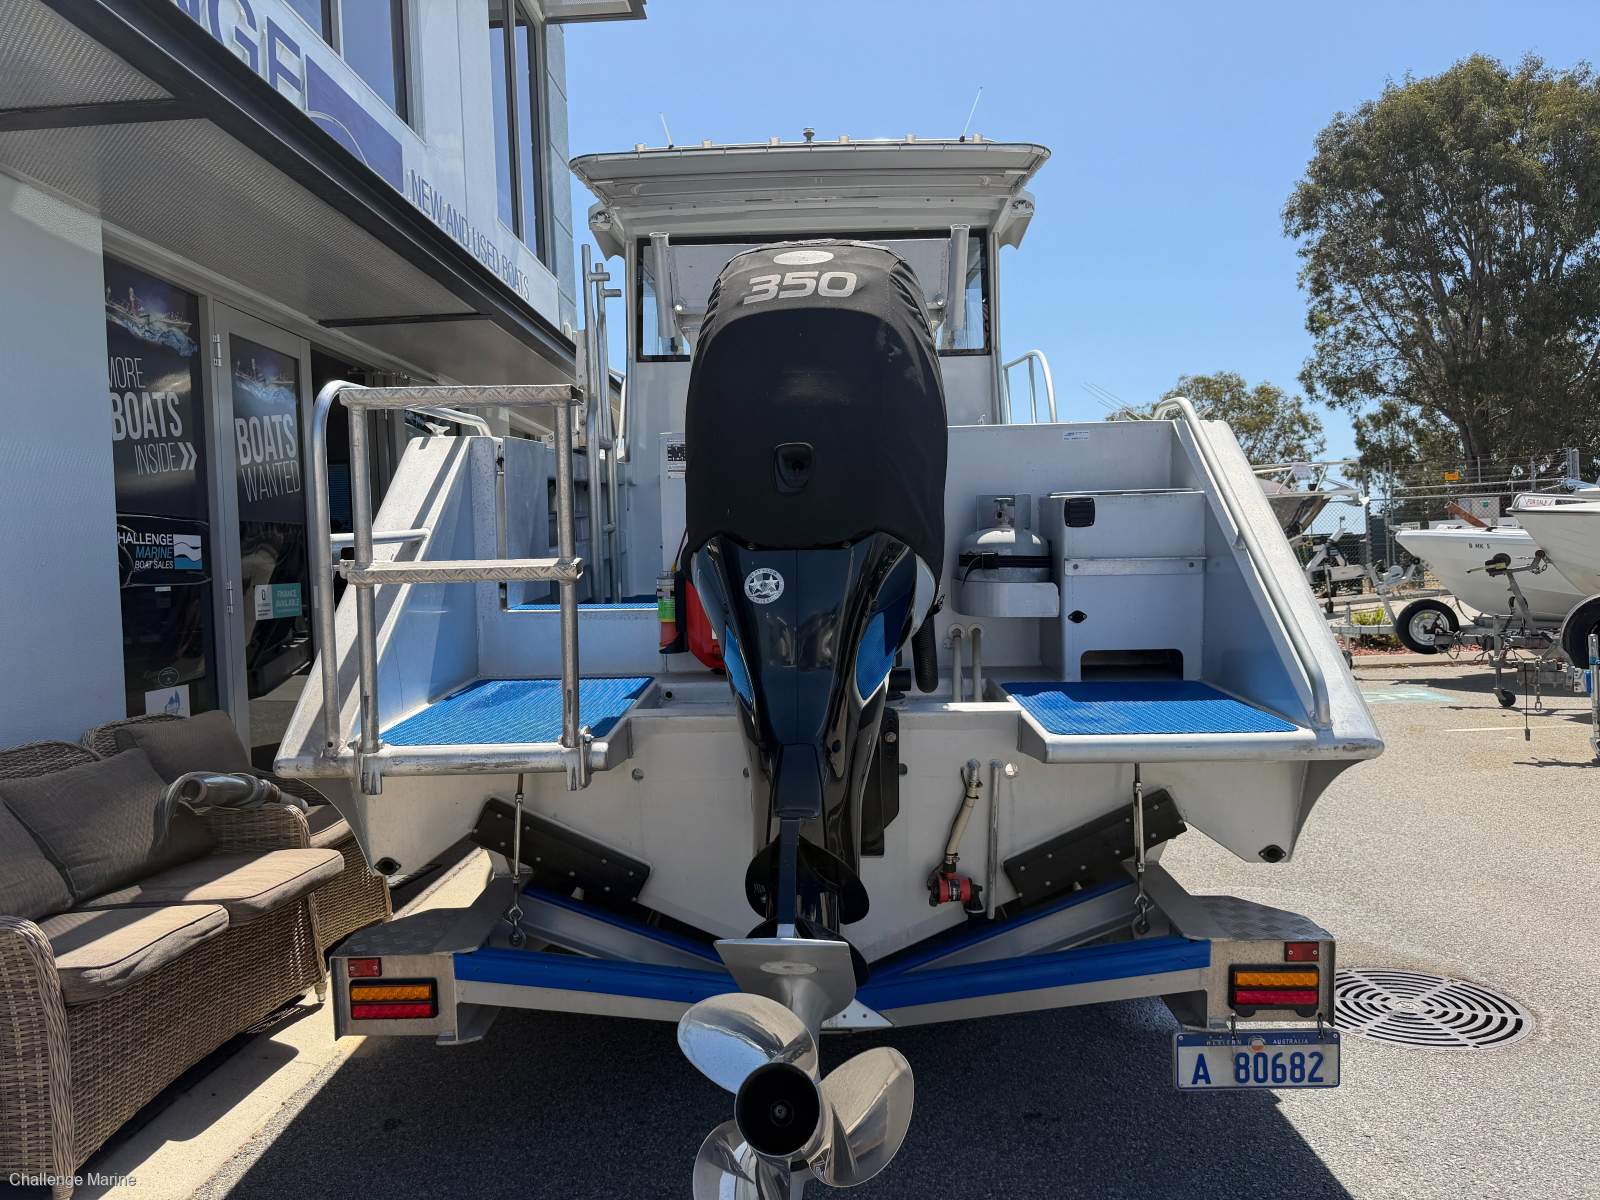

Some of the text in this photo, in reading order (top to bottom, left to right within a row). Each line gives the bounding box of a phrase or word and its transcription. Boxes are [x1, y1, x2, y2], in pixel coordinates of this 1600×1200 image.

[174, 0, 301, 91] GE
[411, 169, 529, 301] NEW AND USED BOATS
[743, 271, 858, 305] 350
[110, 391, 183, 441] BOATS
[134, 442, 179, 475] INSIDE
[234, 414, 297, 465] BOATS
[242, 460, 300, 502] WANTED
[135, 546, 173, 559] MARINE
[135, 560, 174, 569] BOAT SALES
[1191, 1051, 1324, 1085] A 80682
